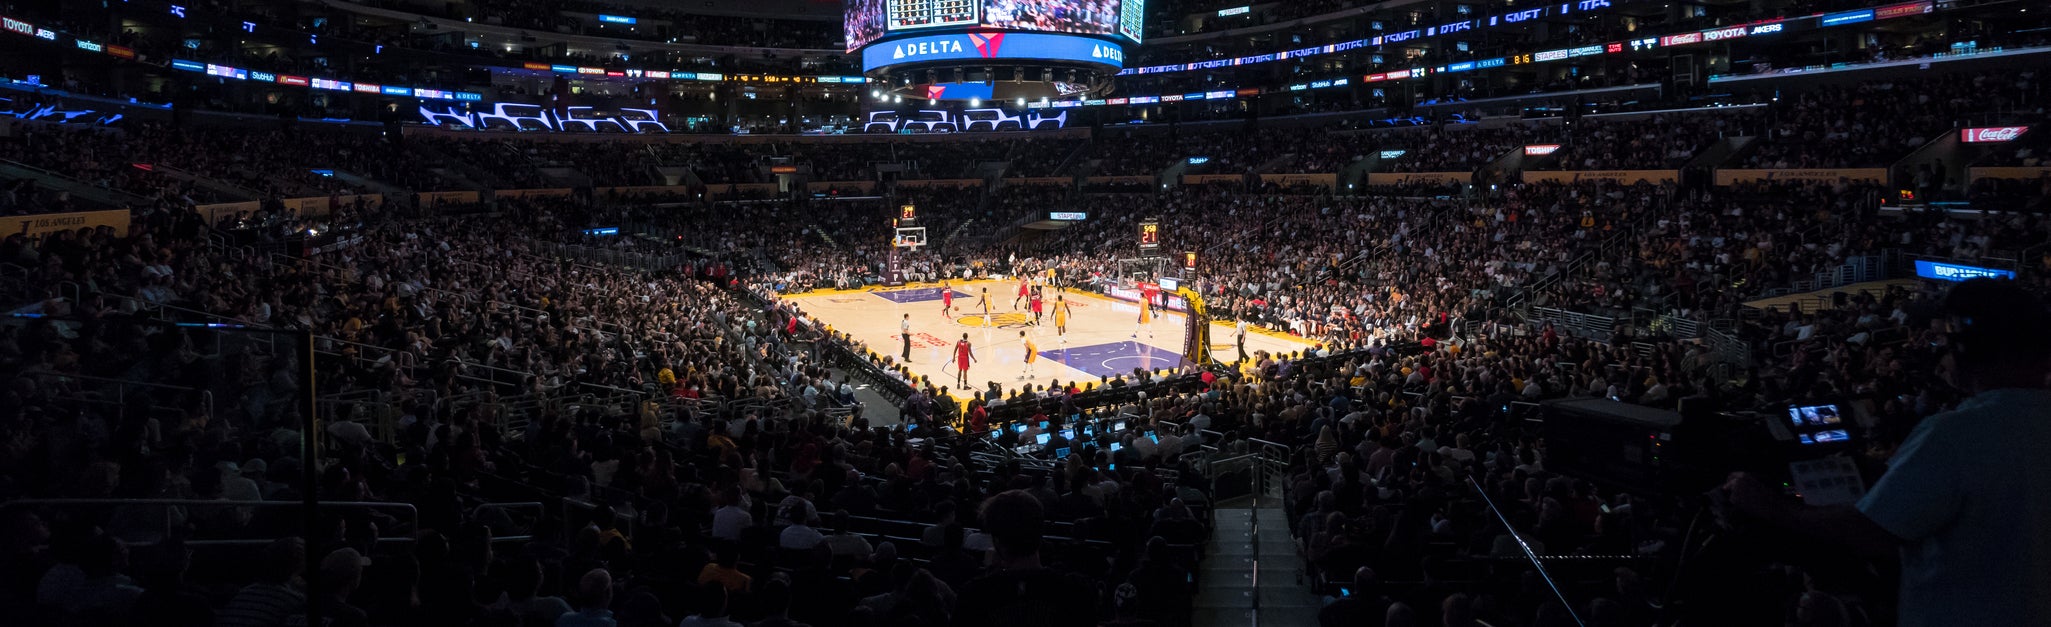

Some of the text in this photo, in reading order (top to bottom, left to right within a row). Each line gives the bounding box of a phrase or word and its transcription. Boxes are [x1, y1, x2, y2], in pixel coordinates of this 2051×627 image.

[3, 17, 33, 35] TOYOTA
[1703, 27, 1746, 41] TOYOTA
[77, 39, 101, 52] verizon
[907, 40, 962, 56] DELTA
[1103, 48, 1122, 63] DELT
[1514, 54, 1530, 65] 8:16
[1535, 50, 1567, 61] STAPLES
[1482, 59, 1504, 67] DELTA
[252, 72, 275, 82] StubHub
[1387, 70, 1410, 79] TOSHIBA
[354, 83, 380, 93] TOSHIBA
[35, 216, 86, 228] LOS ANGELES
[1143, 231, 1155, 243] 21
[1934, 265, 1959, 278] BUD
